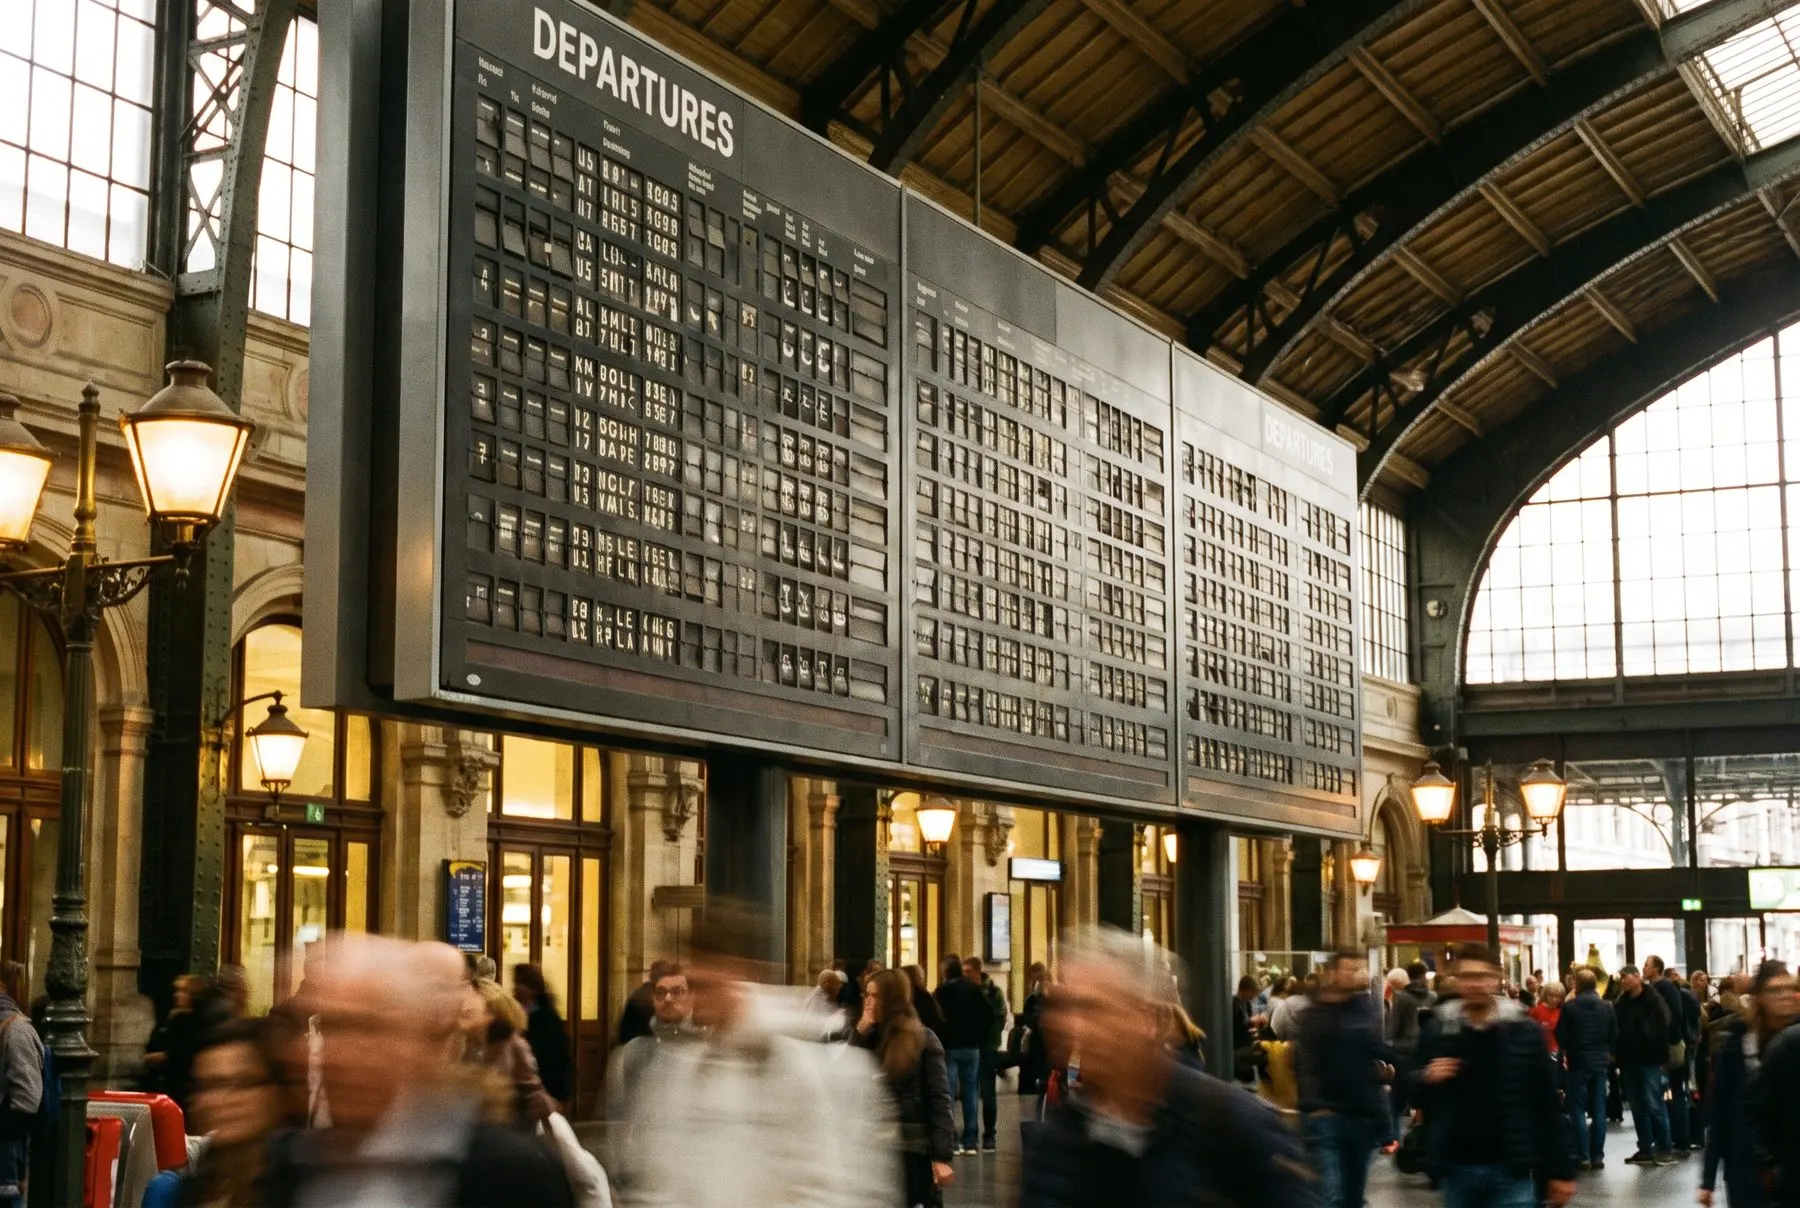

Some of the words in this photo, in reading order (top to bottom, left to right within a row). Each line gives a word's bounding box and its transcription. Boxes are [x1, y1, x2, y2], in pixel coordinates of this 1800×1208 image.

[534, 7, 734, 158] DEPARTURES
[576, 297, 593, 319] AL
[1265, 414, 1333, 476] DEPARTURES
